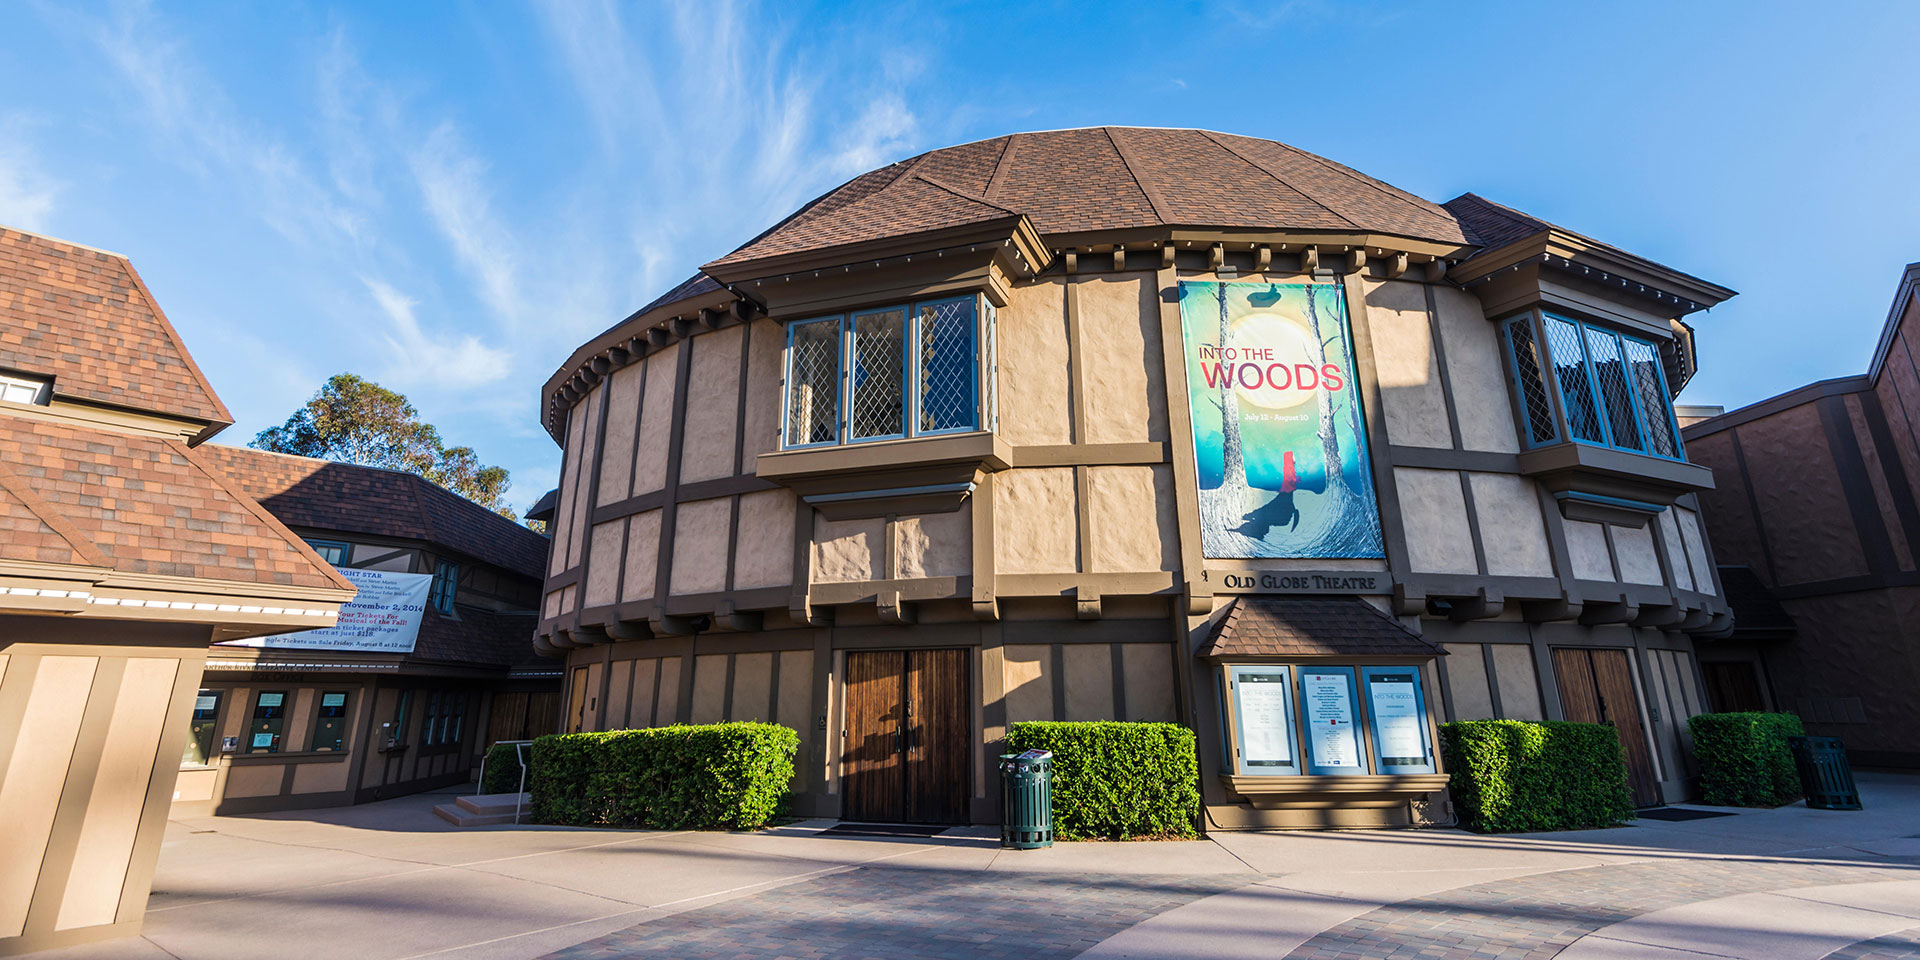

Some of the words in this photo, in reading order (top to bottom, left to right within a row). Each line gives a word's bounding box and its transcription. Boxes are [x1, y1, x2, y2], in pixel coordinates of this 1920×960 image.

[1199, 347, 1237, 360] INTO
[1241, 348, 1274, 361] THE
[1200, 362, 1344, 392] WOODS
[1244, 413, 1259, 422] July
[1260, 413, 1269, 421] 12
[1274, 413, 1299, 423] August
[1300, 414, 1309, 422] 10
[362, 571, 382, 579] STAR
[1224, 575, 1256, 589] OLD
[1261, 575, 1309, 589] GLOBE
[1312, 575, 1376, 589] THEATRE
[344, 601, 390, 611] November
[392, 604, 401, 612] 2,
[402, 604, 423, 613] 2014
[265, 708, 273, 717] 2
[328, 707, 336, 716] 3
